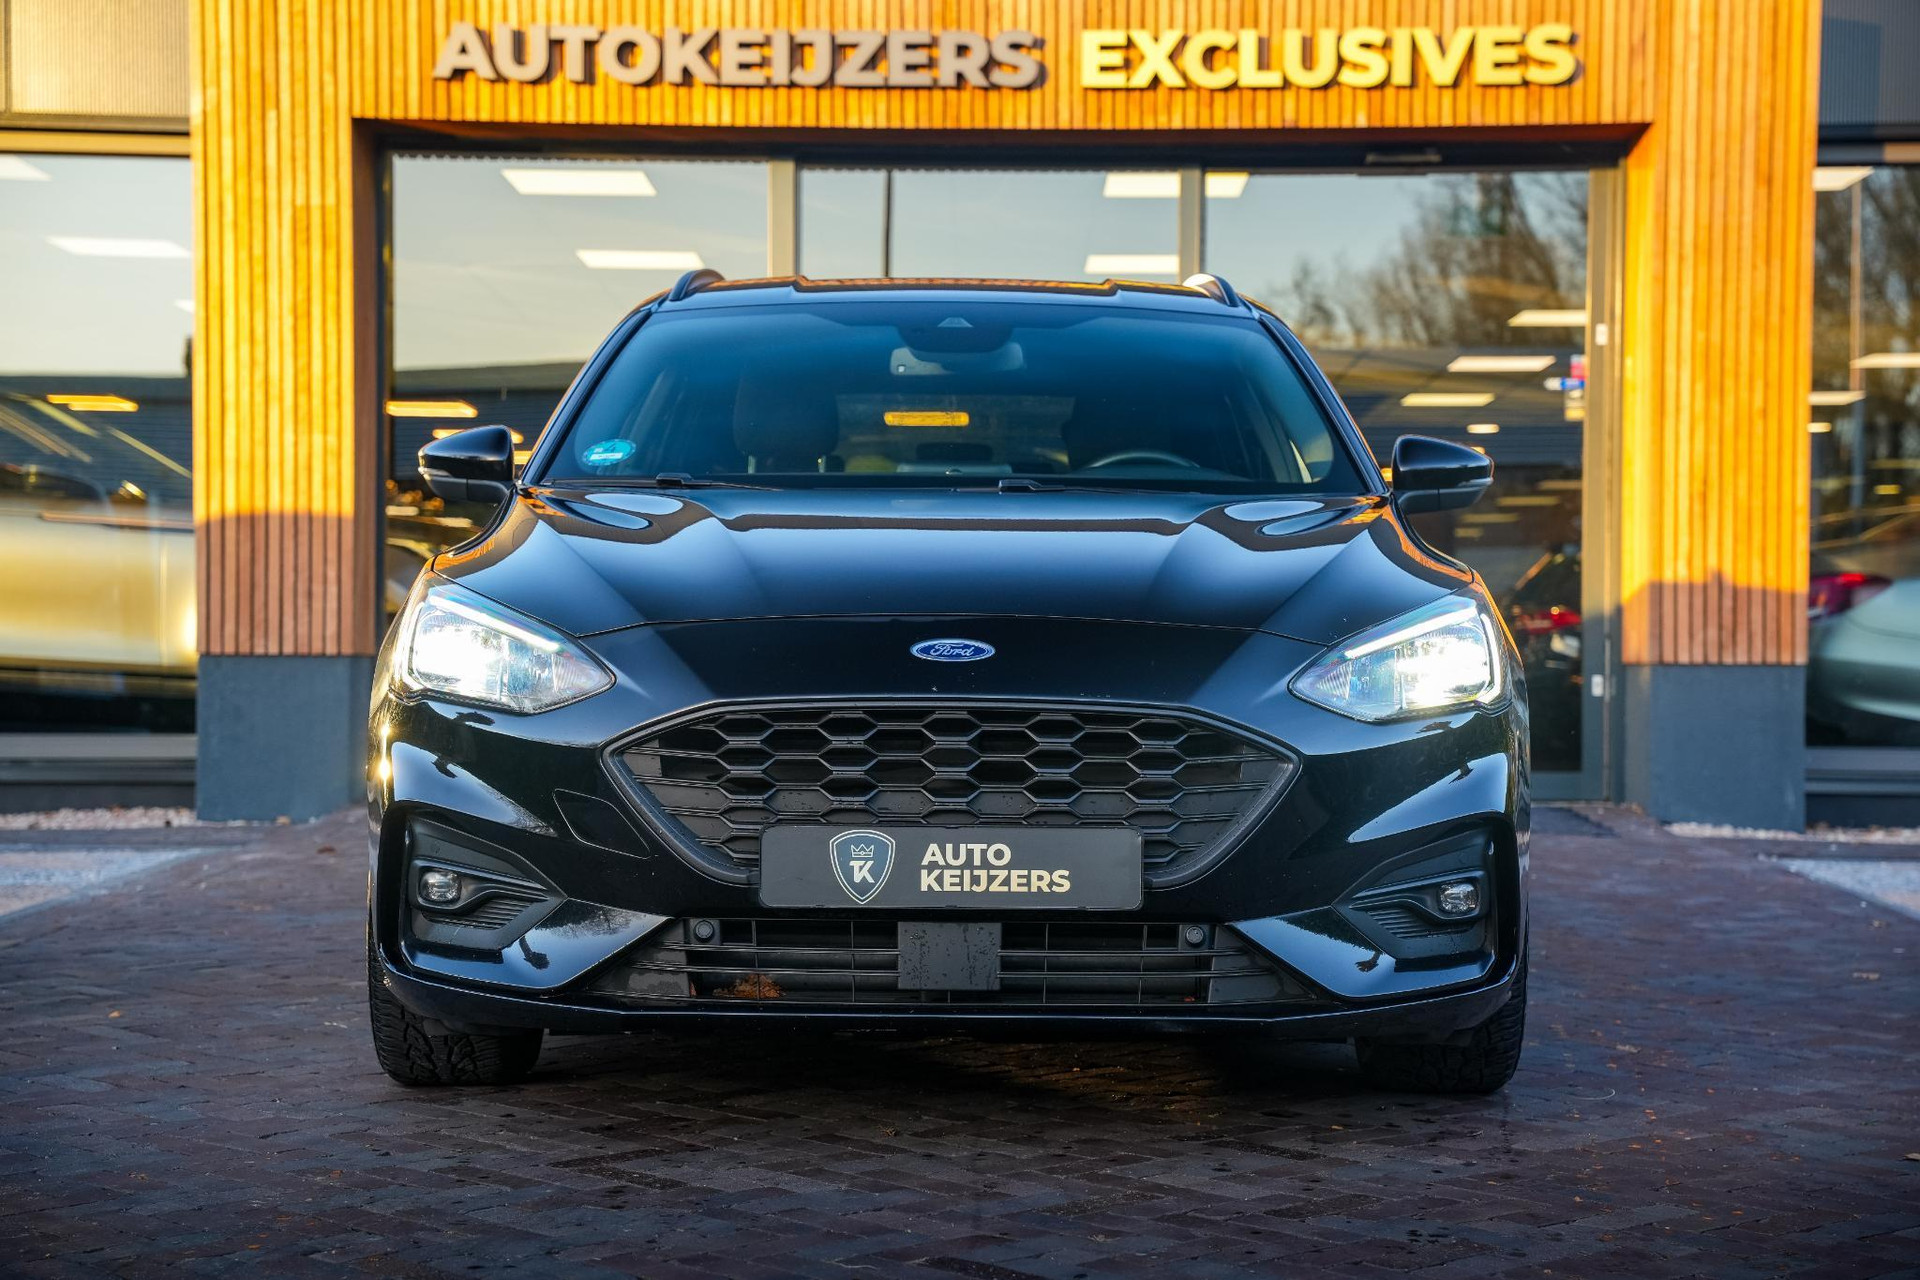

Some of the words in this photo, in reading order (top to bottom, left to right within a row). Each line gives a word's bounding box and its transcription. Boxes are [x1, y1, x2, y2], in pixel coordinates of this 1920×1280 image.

[433, 23, 1044, 88] AUTOKEIJZERS
[1081, 24, 1578, 89] EXCLUSIVES
[929, 642, 974, 656] Ford
[921, 843, 1011, 866] AUTO
[920, 869, 1070, 892] KEIJZERS
